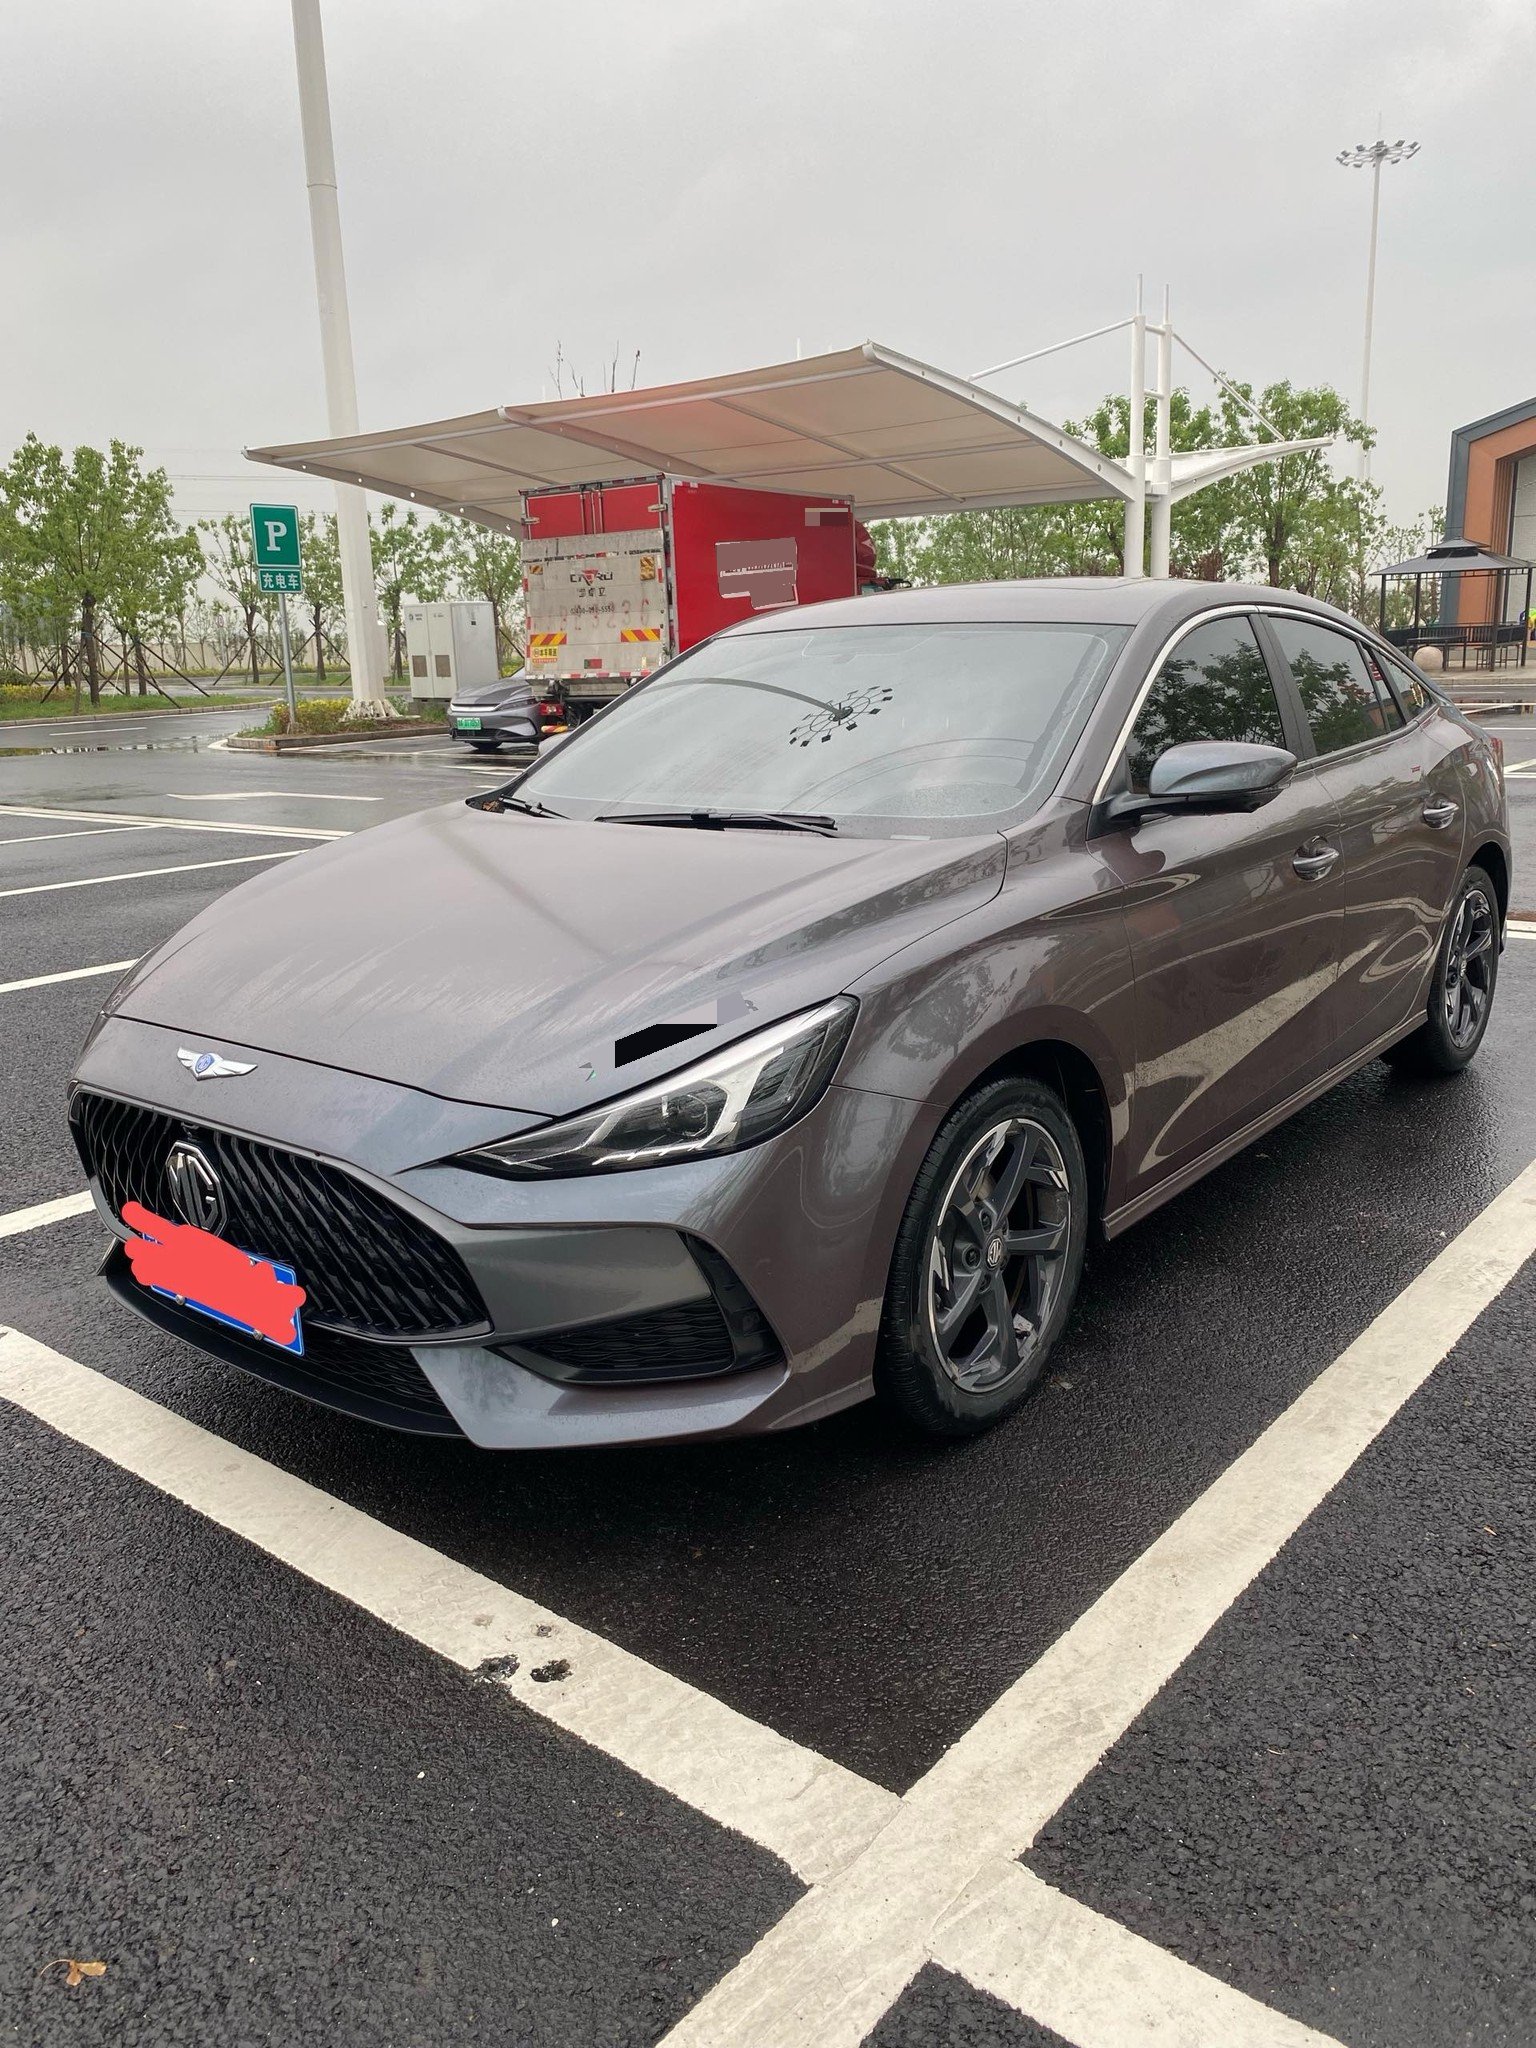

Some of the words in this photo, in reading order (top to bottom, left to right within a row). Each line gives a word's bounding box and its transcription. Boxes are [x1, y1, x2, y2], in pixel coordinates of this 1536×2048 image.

[264, 521, 287, 551] P
[262, 573, 299, 589] 充电车
[167, 1152, 220, 1231] MG
